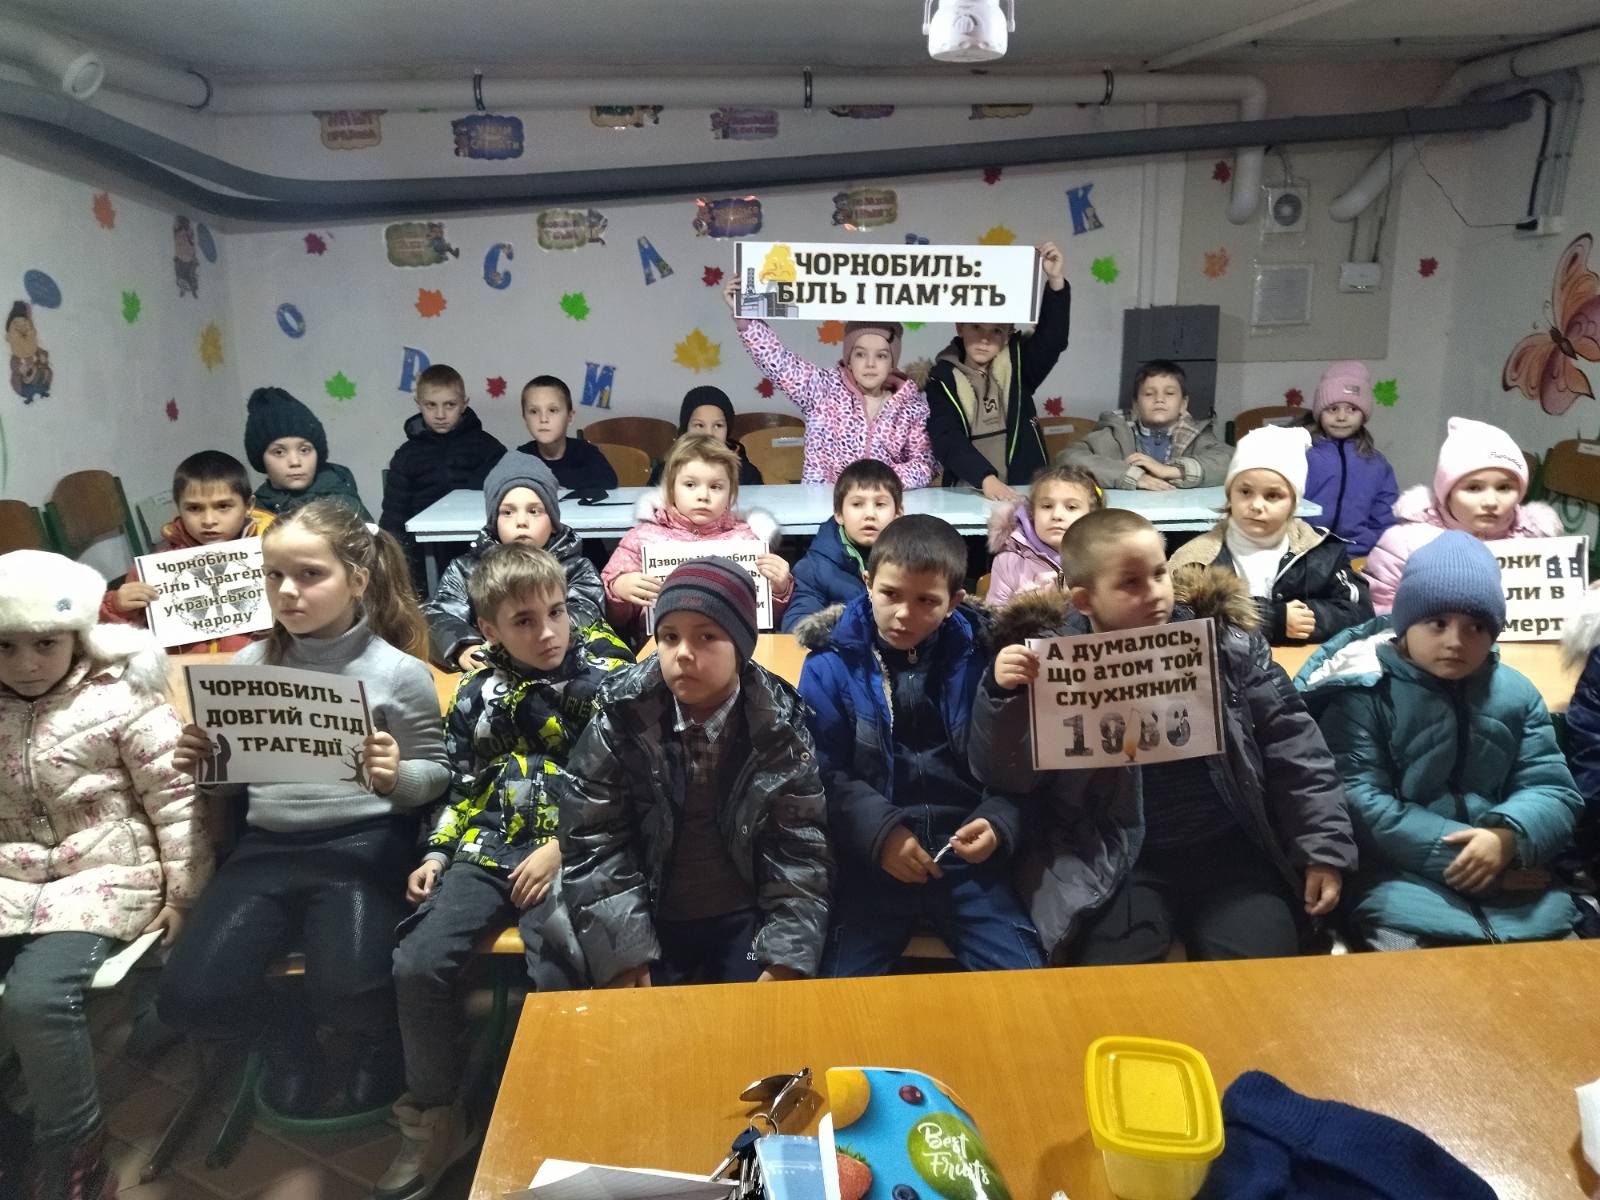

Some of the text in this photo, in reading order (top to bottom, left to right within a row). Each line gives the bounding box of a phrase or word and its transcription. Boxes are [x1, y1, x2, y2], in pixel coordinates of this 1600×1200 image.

[795, 252, 983, 278] ЧОРНОБИЛЬ:
[777, 281, 848, 305] БІЛЬ
[857, 283, 866, 305] І
[156, 551, 249, 574] Чорнобиль
[1496, 554, 1542, 569] они
[163, 587, 265, 617] українськог
[1505, 586, 1542, 601] ли
[193, 611, 253, 630] народу
[1500, 616, 1565, 636] мерт
[1046, 629, 1200, 663] А думалось,
[1047, 646, 1203, 686] що атом той
[199, 679, 343, 704] ЧОРНОБИЛЬ
[1056, 672, 1198, 709] слухняний
[206, 706, 365, 736] ДОВГИЙ СЛІД
[237, 736, 344, 758] ТРАГЕДІЇ
[917, 1122, 969, 1160] Best
[922, 1151, 990, 1186] Fruits
